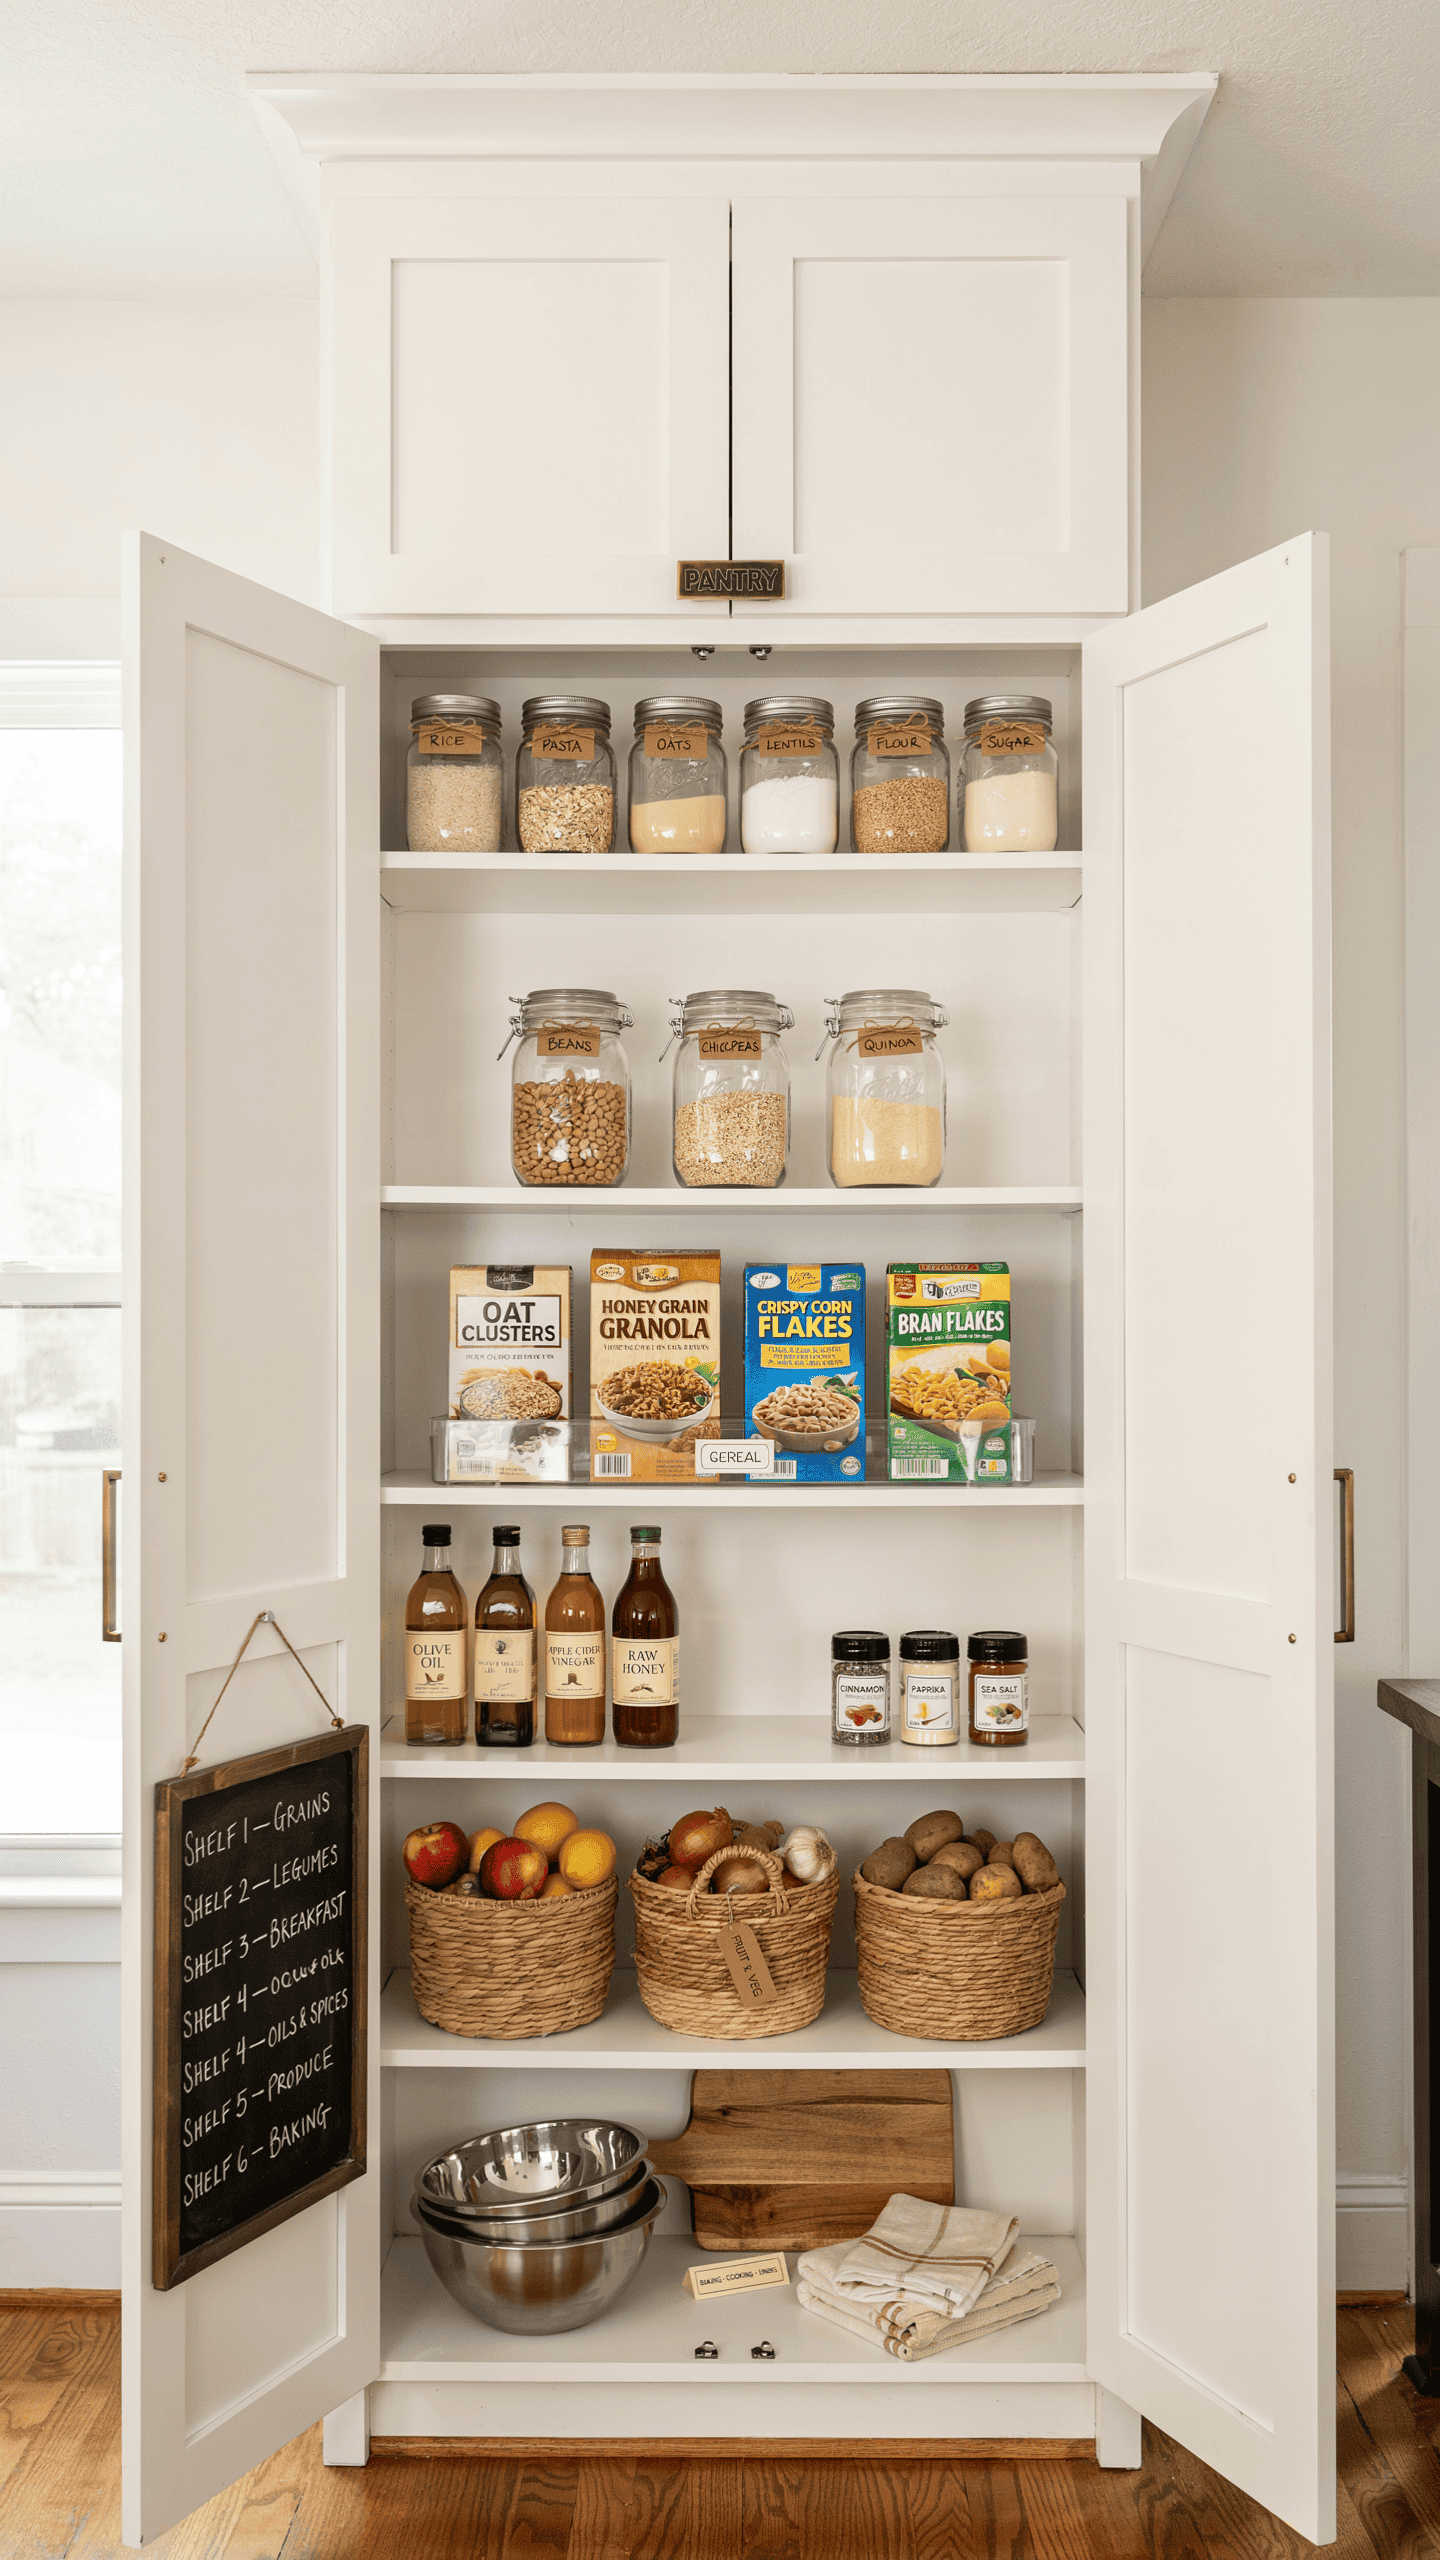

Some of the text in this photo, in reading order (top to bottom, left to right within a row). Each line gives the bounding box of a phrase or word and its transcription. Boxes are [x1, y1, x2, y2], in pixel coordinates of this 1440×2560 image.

[685, 568, 778, 591] PANTRY
[430, 734, 465, 747] RICE
[542, 738, 583, 753] PASTA
[657, 738, 692, 751] OATS
[766, 738, 816, 749] LENTILS
[877, 736, 921, 749] FLOUR
[988, 736, 1035, 749] SUGAR
[548, 1037, 592, 1052] BEANS
[864, 1038, 916, 1052] QUINOA
[482, 1301, 536, 1324] OAT
[602, 1299, 709, 1314] HONEY GRAIN
[757, 1300, 852, 1314] CRISPY CORN
[599, 1317, 711, 1340] GRANOLA
[758, 1315, 853, 1338] FLAKES
[898, 1310, 1005, 1335] BRAN FLAKES
[461, 1325, 556, 1342] CLUSTERS
[413, 1644, 452, 1656] OLIVE
[547, 1646, 601, 1655] APPLE CIDER
[628, 1650, 658, 1661] RAW
[420, 1656, 445, 1669] OIL
[552, 1657, 595, 1666] VINEGAR
[622, 1663, 665, 1674] HONEY
[840, 1684, 885, 1693] CINNAMON
[911, 1685, 946, 1693] PAPRIKA
[981, 1685, 1018, 1694] SEA SALT
[184, 1821, 237, 1867] SHELF
[183, 1885, 233, 1928] SHELF
[183, 1940, 233, 1983] SHELF
[731, 1934, 750, 1961] FRUIT
[748, 1973, 763, 1997] VEG
[183, 1995, 231, 2039] SHELF
[183, 2048, 231, 2094] SHELF
[309, 1988, 349, 2024] SPICES
[183, 2098, 232, 2148] SHELF
[183, 2153, 233, 2207] SHELF
